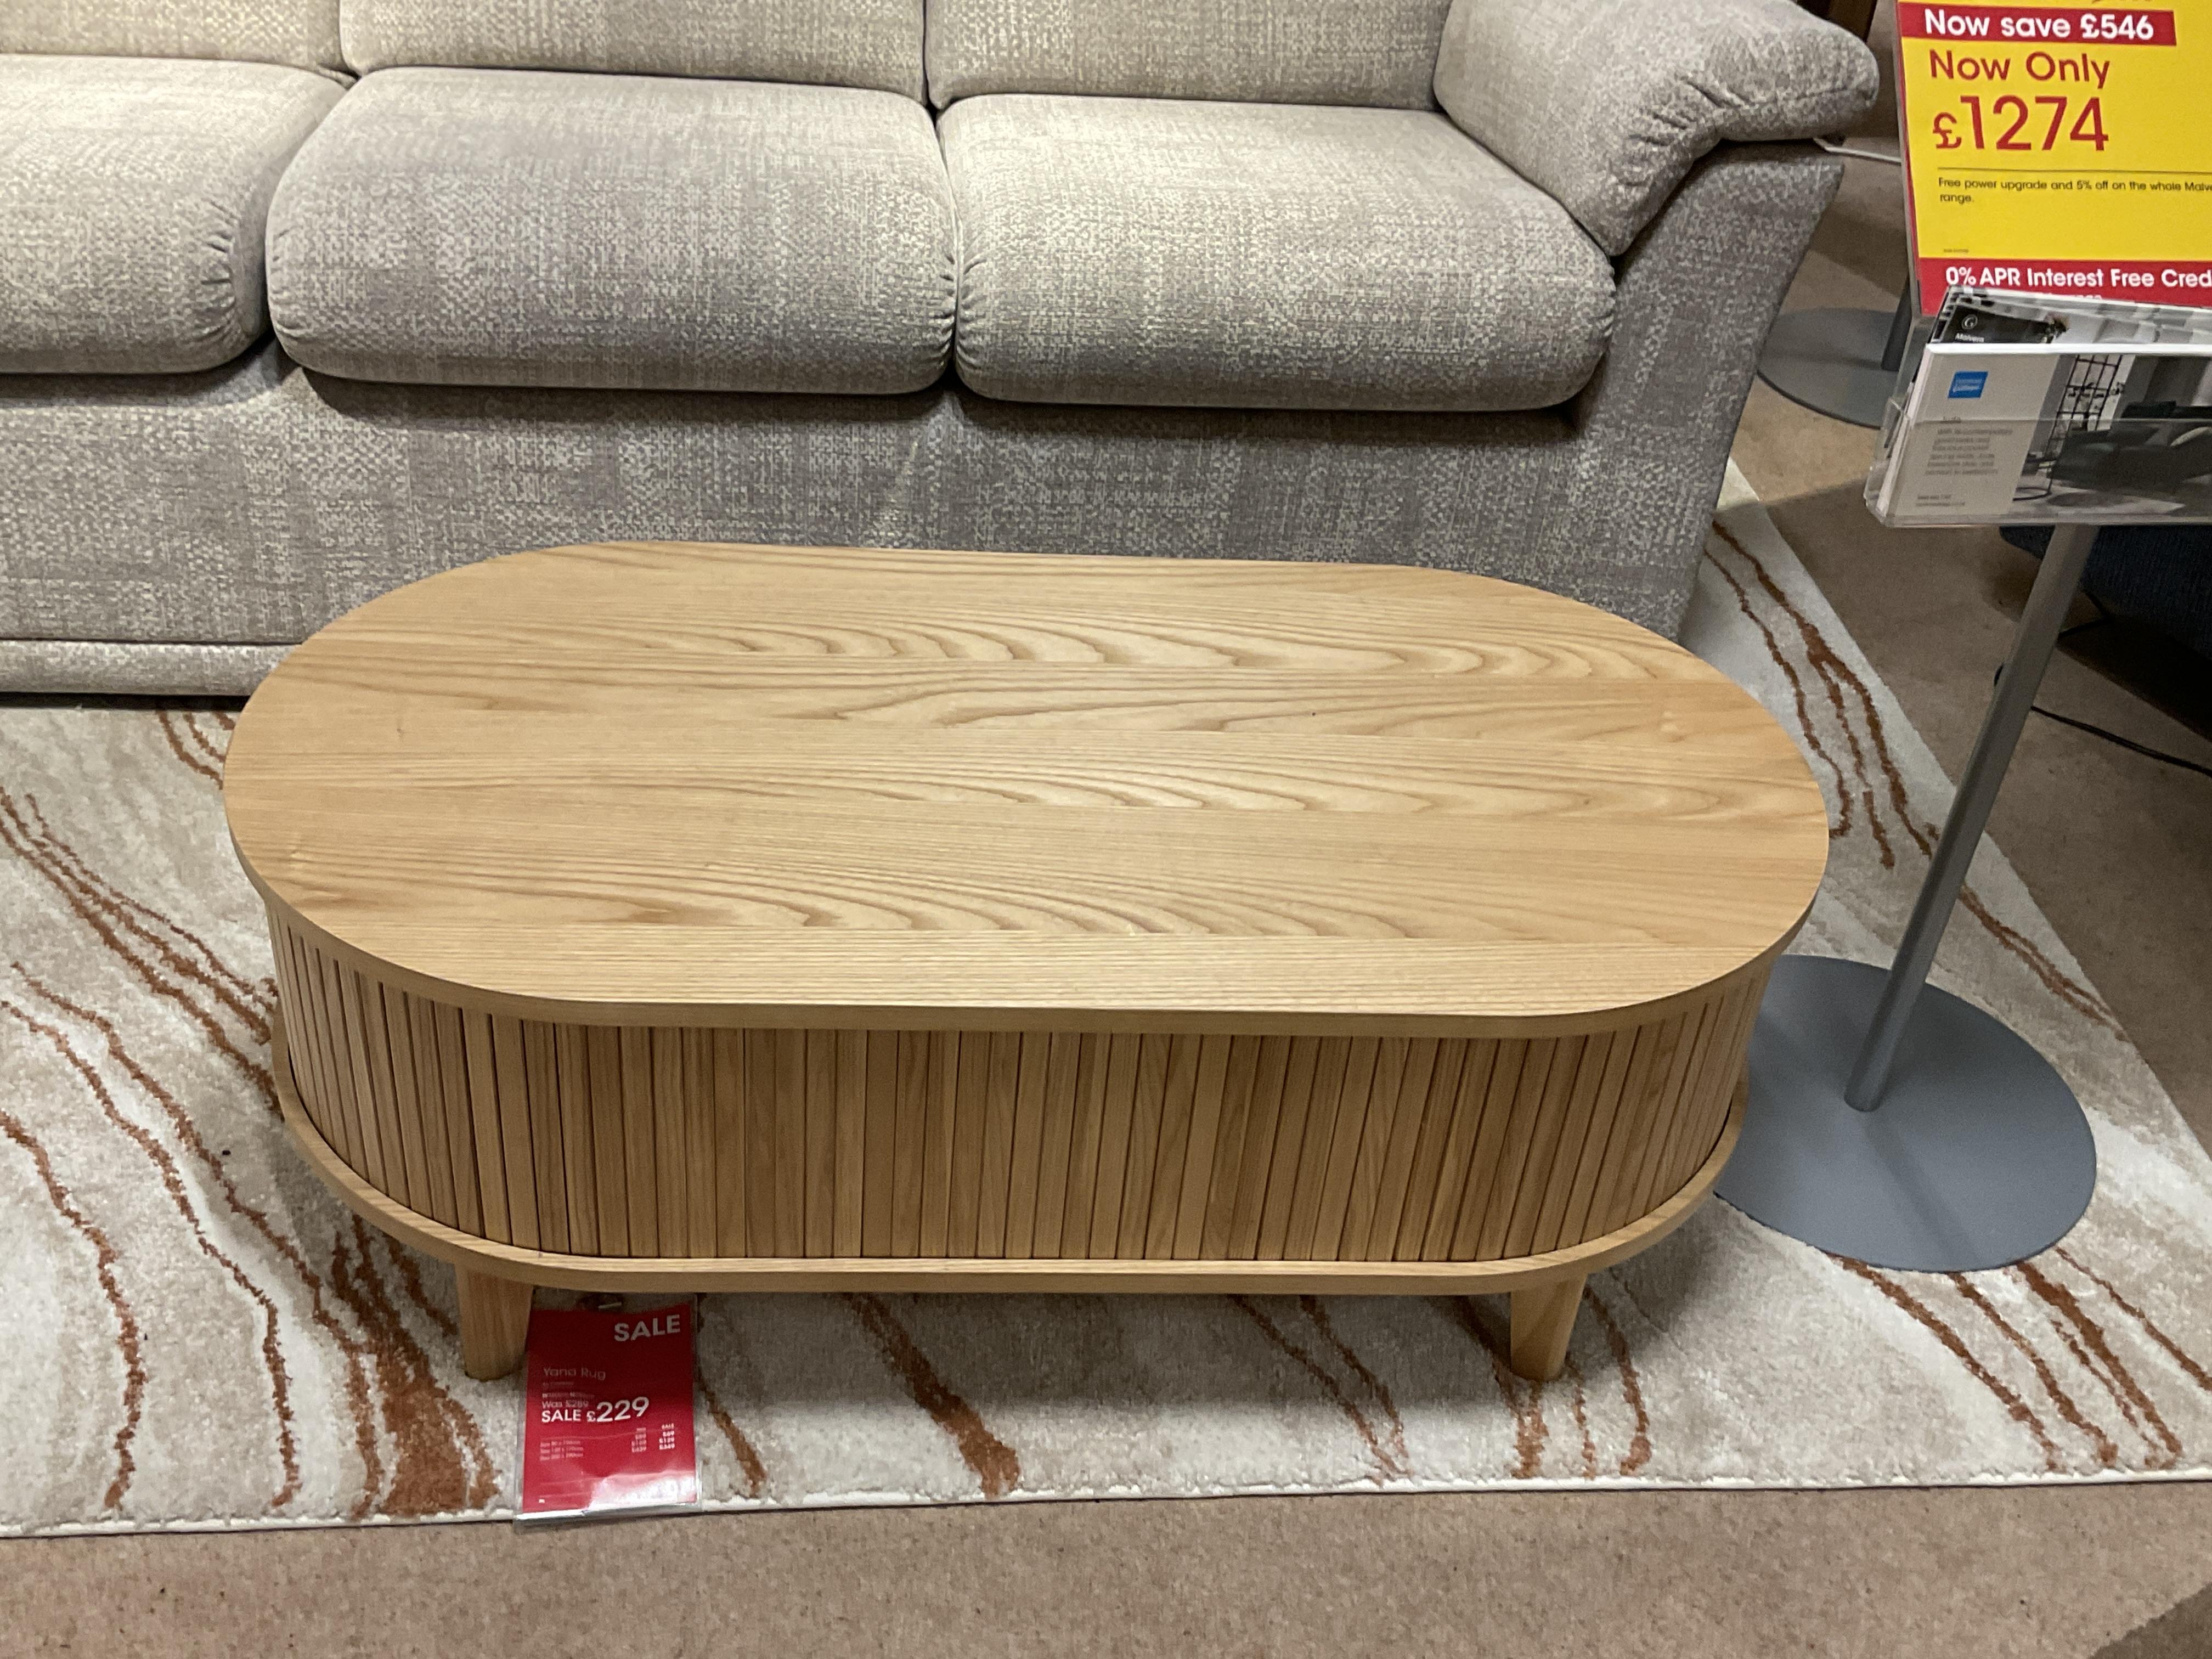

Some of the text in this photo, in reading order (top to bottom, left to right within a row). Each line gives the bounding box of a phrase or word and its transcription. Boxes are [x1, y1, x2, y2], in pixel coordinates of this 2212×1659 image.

[1924, 9, 2154, 40] Now save £546
[1929, 49, 2111, 89] Now Only
[1932, 95, 2109, 152] £1274
[1939, 177, 1961, 188] Free
[1965, 179, 1997, 190] power
[2001, 179, 2047, 191] upgrade
[2051, 180, 2073, 190] and
[2095, 180, 2108, 190] off
[2112, 182, 2126, 190] on
[2129, 181, 2146, 190] the
[2150, 181, 2182, 191] whole
[1940, 195, 1974, 204] range.
[1945, 267, 1976, 286] 0%
[1979, 268, 2021, 286] APR
[2027, 268, 2104, 287] Interest
[2111, 269, 2155, 288] Free
[614, 1314, 681, 1342] SALE
[581, 1367, 606, 1381] Rug
[541, 1400, 563, 1409] Was
[541, 1396, 650, 1423] SALE £229
